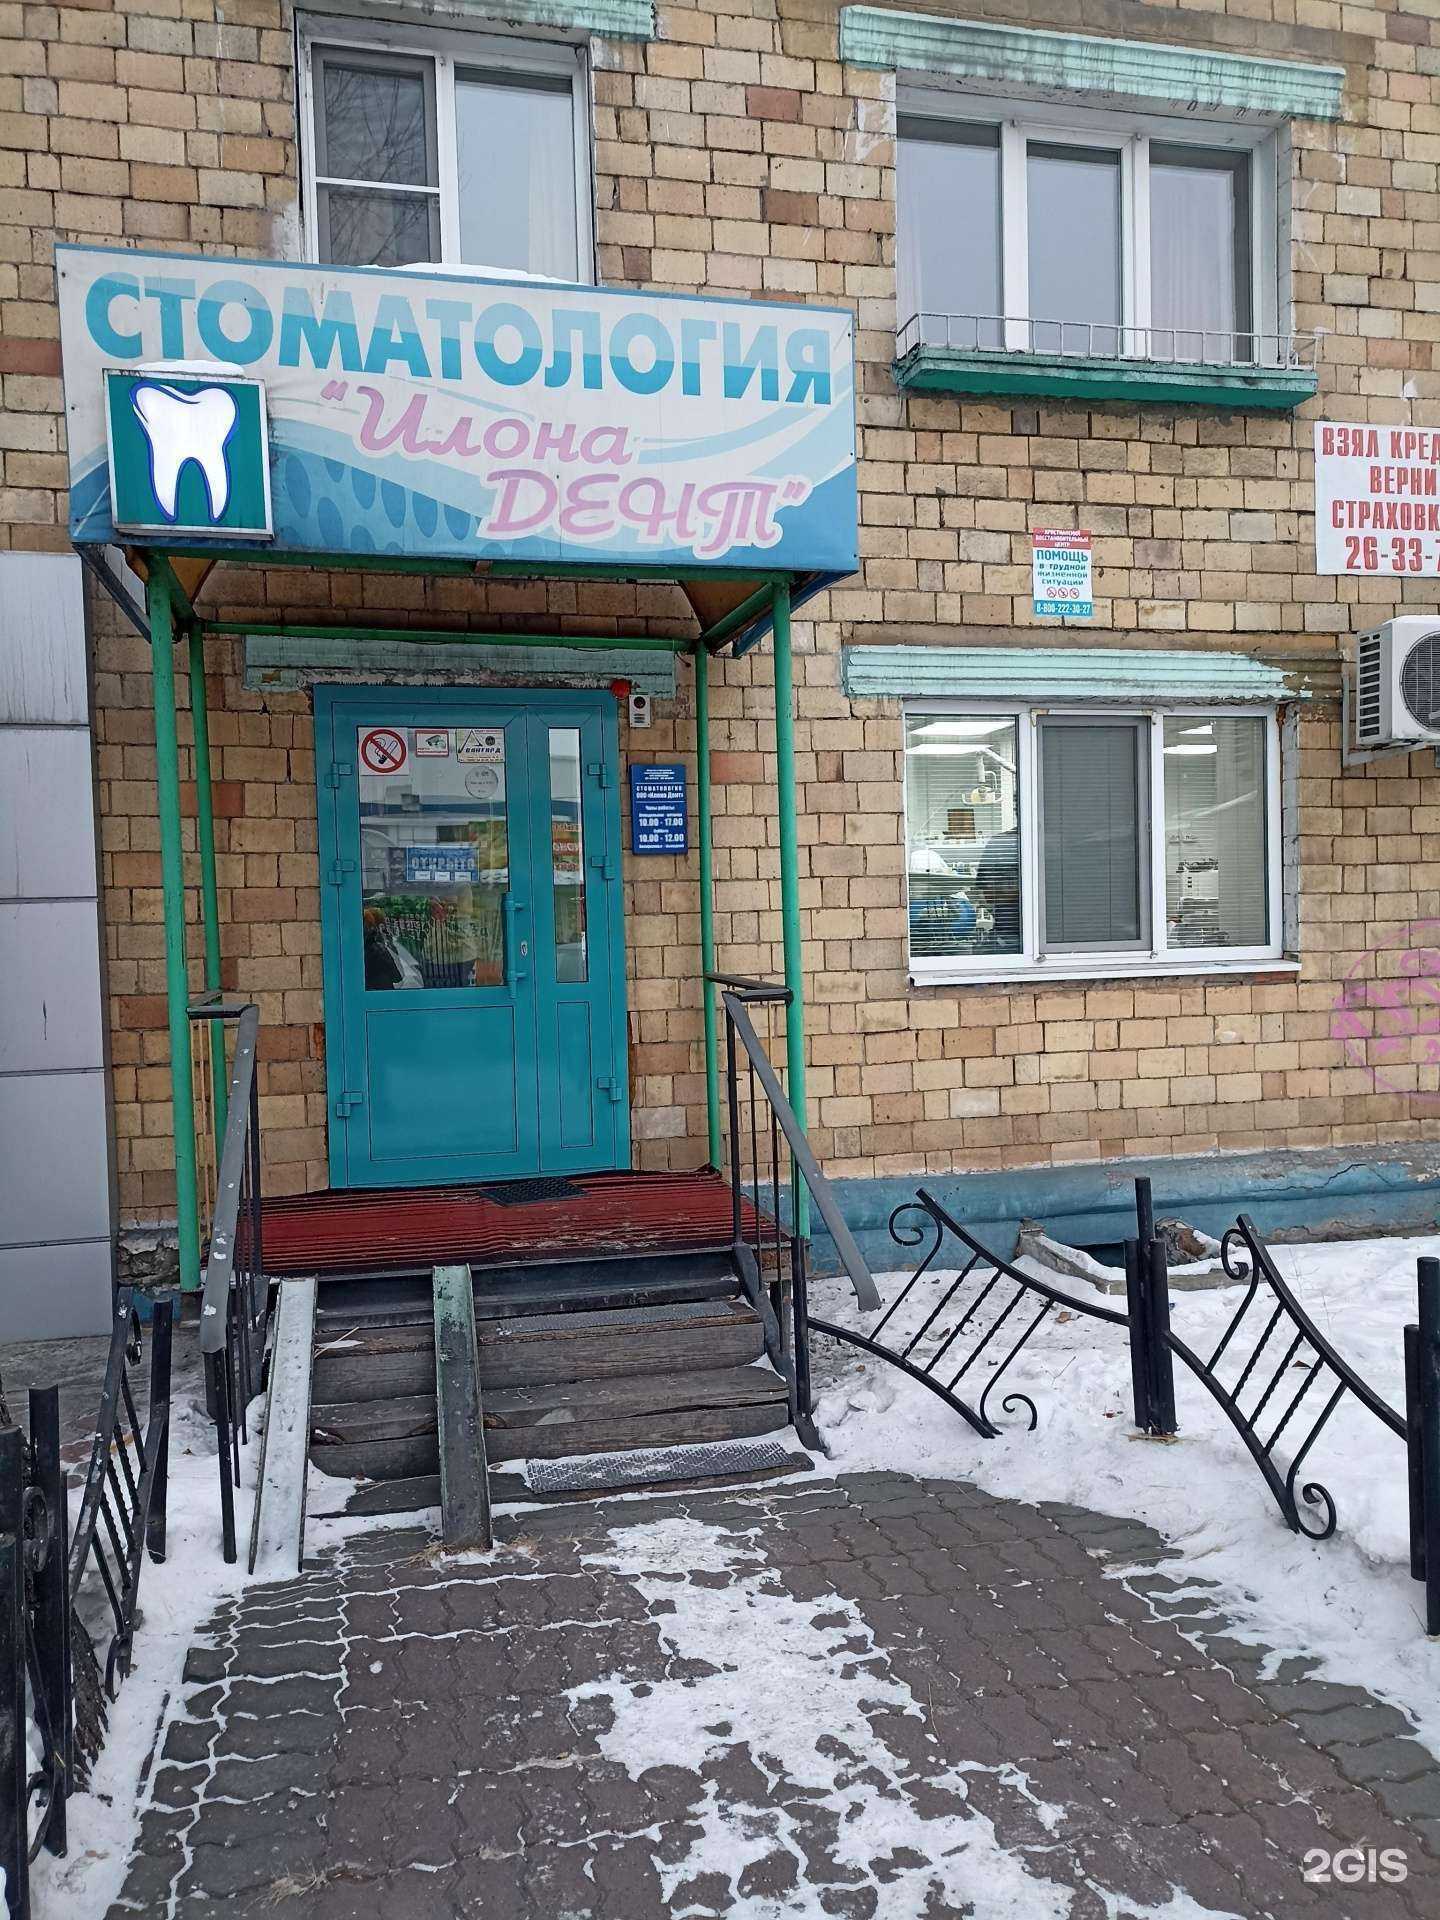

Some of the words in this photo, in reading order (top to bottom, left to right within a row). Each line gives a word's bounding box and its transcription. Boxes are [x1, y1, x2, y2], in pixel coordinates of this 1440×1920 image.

[85, 272, 832, 405] СТОМАТОЛОГИЯ
[1322, 427, 1380, 458] ВЗЯЛ
[1370, 466, 1437, 496] ВЕРНИ
[1332, 500, 1440, 532] СТРАХОВК
[1036, 550, 1089, 563] ПОМОЩЬ
[1049, 563, 1086, 571] трудной
[639, 818, 659, 826] 10.00
[665, 818, 683, 826] 17.00
[639, 834, 659, 842] 10.00
[665, 834, 684, 842] 12.00
